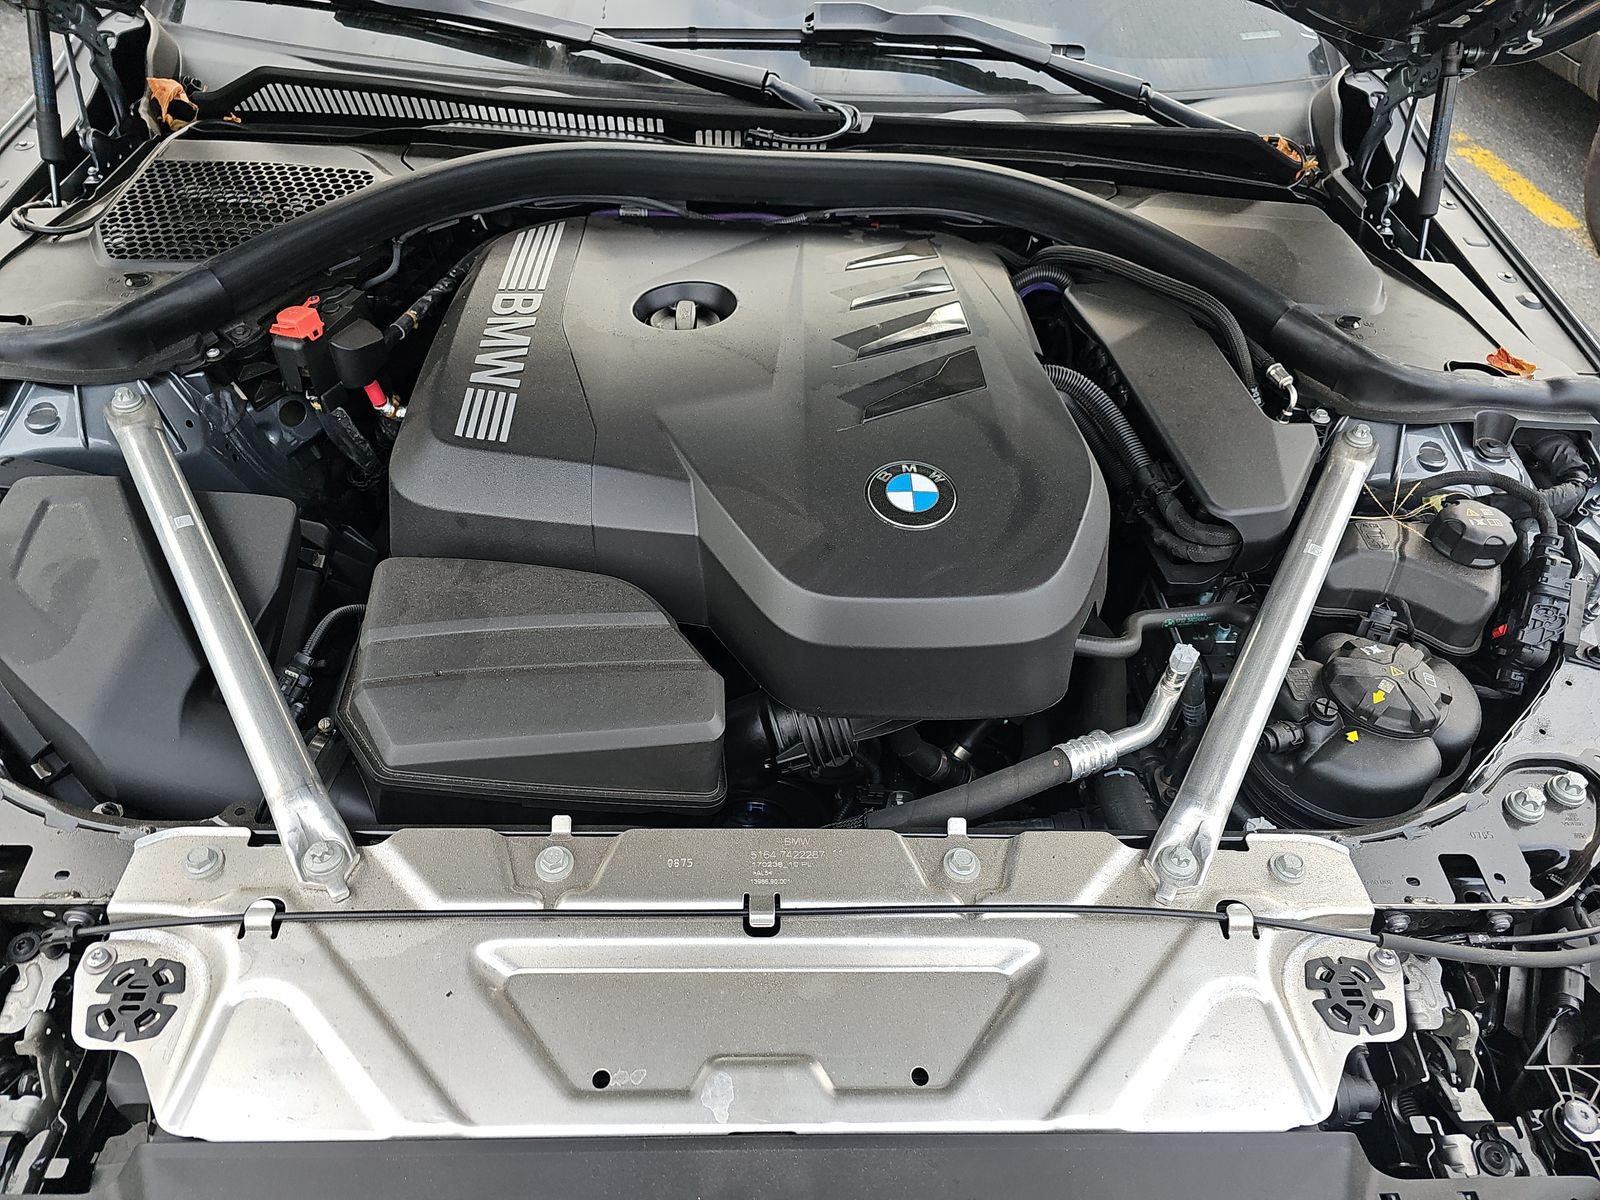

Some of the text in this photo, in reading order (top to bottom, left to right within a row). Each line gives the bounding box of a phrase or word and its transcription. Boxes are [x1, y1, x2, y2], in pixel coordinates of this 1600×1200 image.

[469, 293, 544, 388] BMW
[876, 464, 945, 482] BMW
[784, 837, 811, 846] BMW
